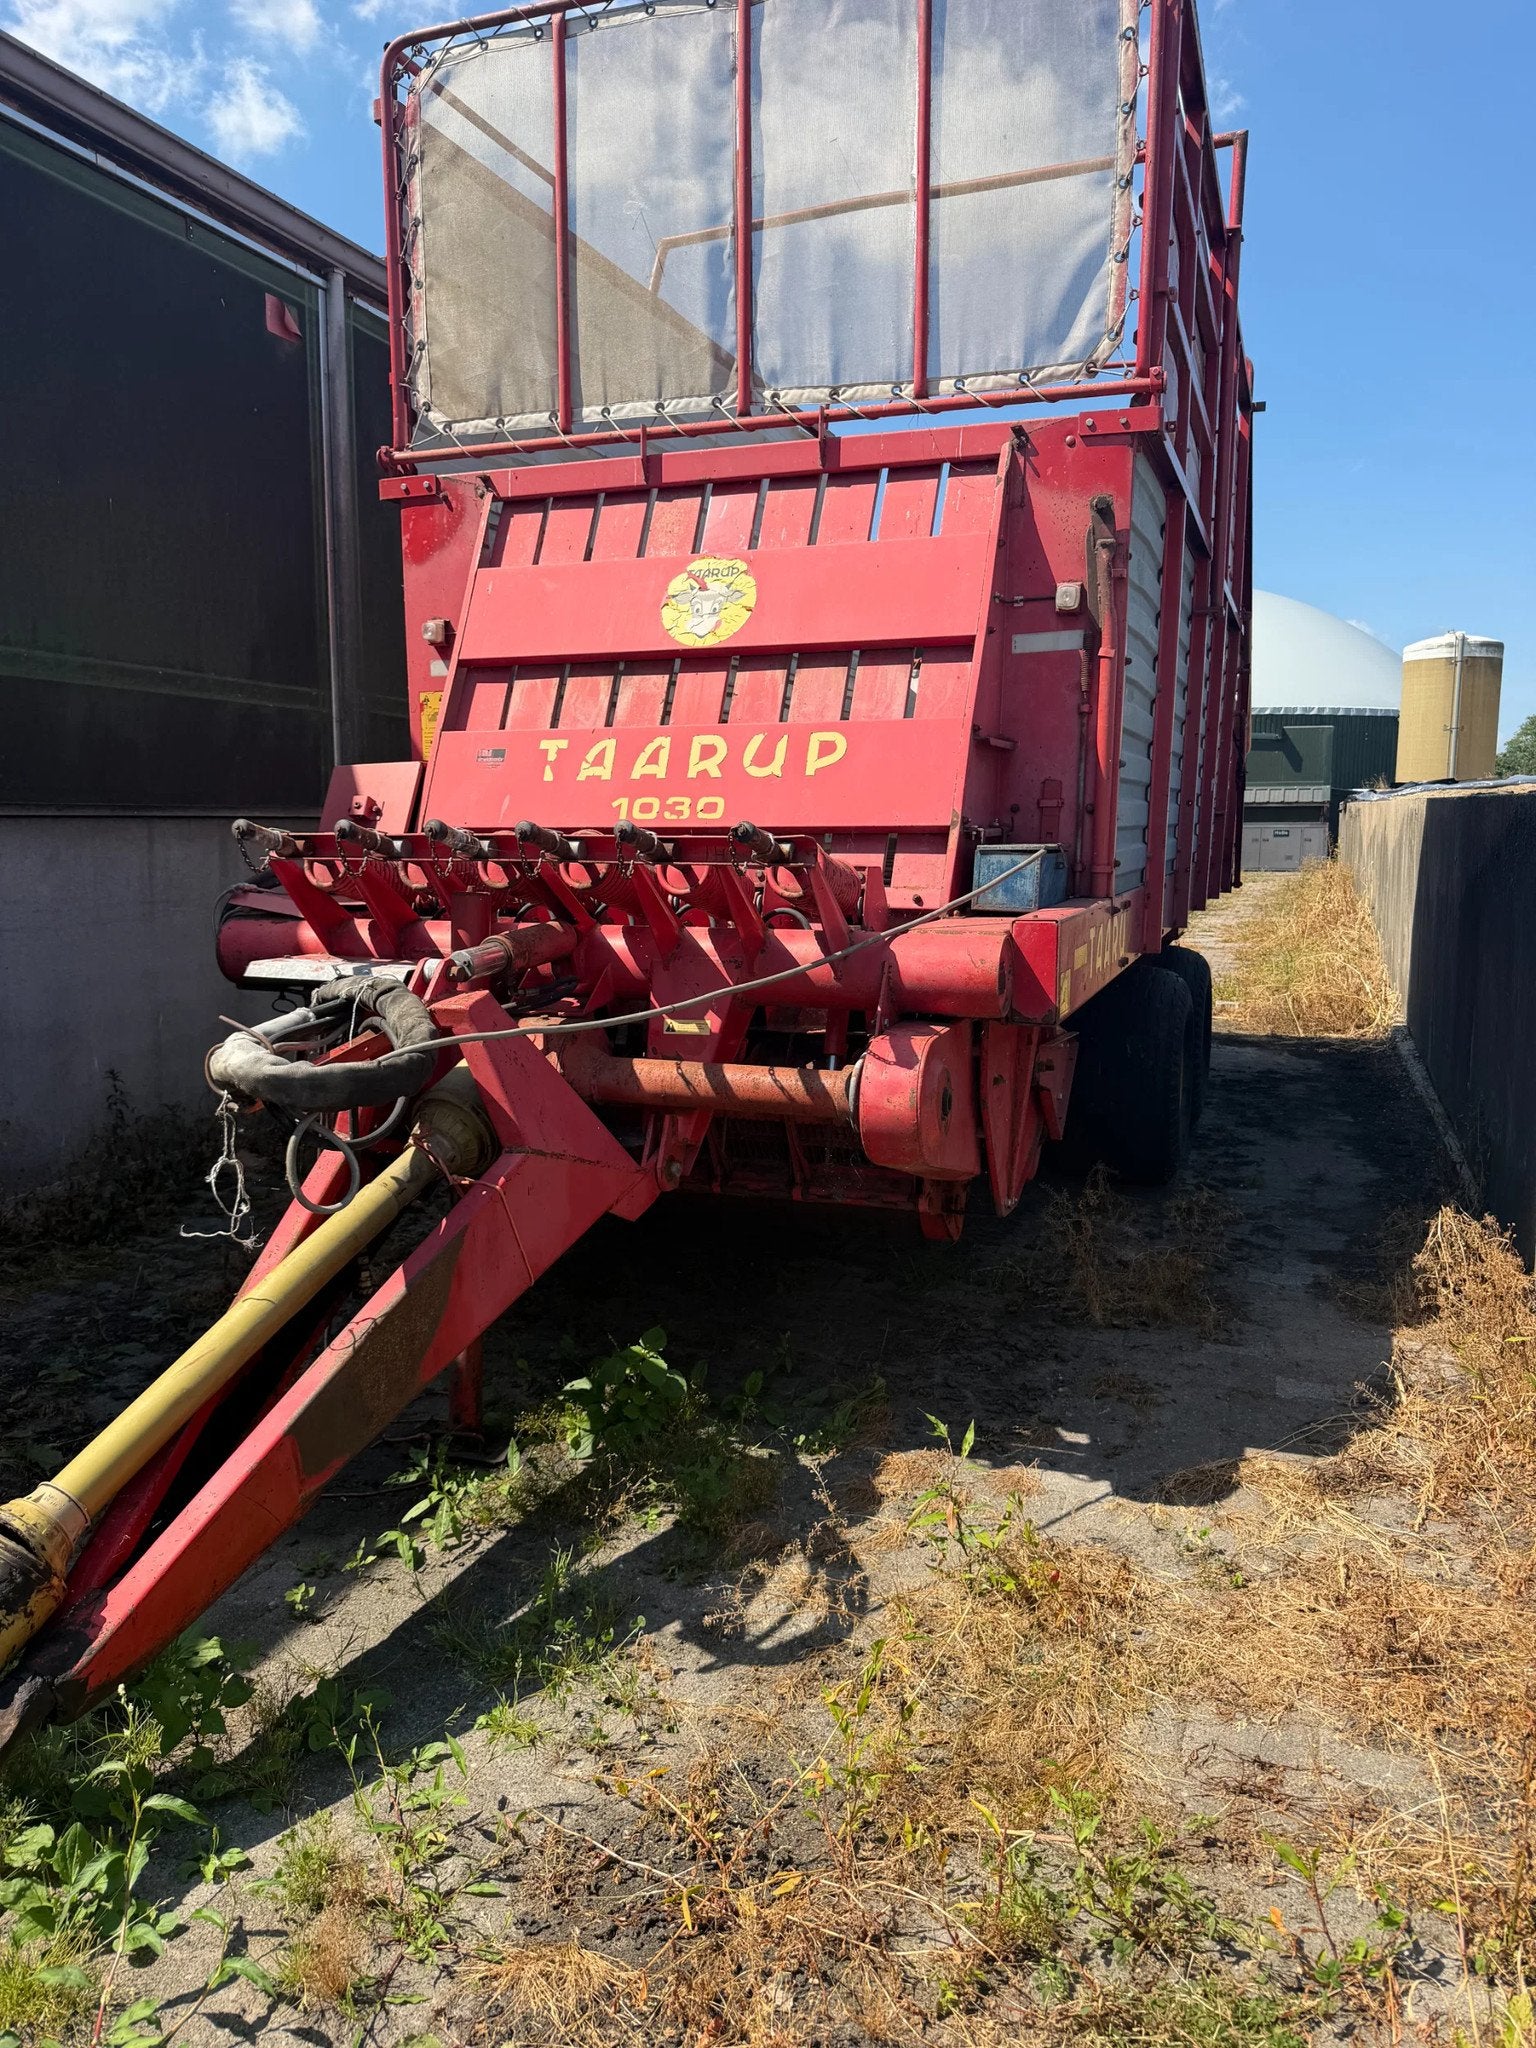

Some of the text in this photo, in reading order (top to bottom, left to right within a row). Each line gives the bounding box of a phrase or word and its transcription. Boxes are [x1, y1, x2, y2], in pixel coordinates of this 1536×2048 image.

[539, 731, 848, 782] TAARUP
[611, 796, 725, 820] 1030
[1089, 909, 1127, 978] TAARU
